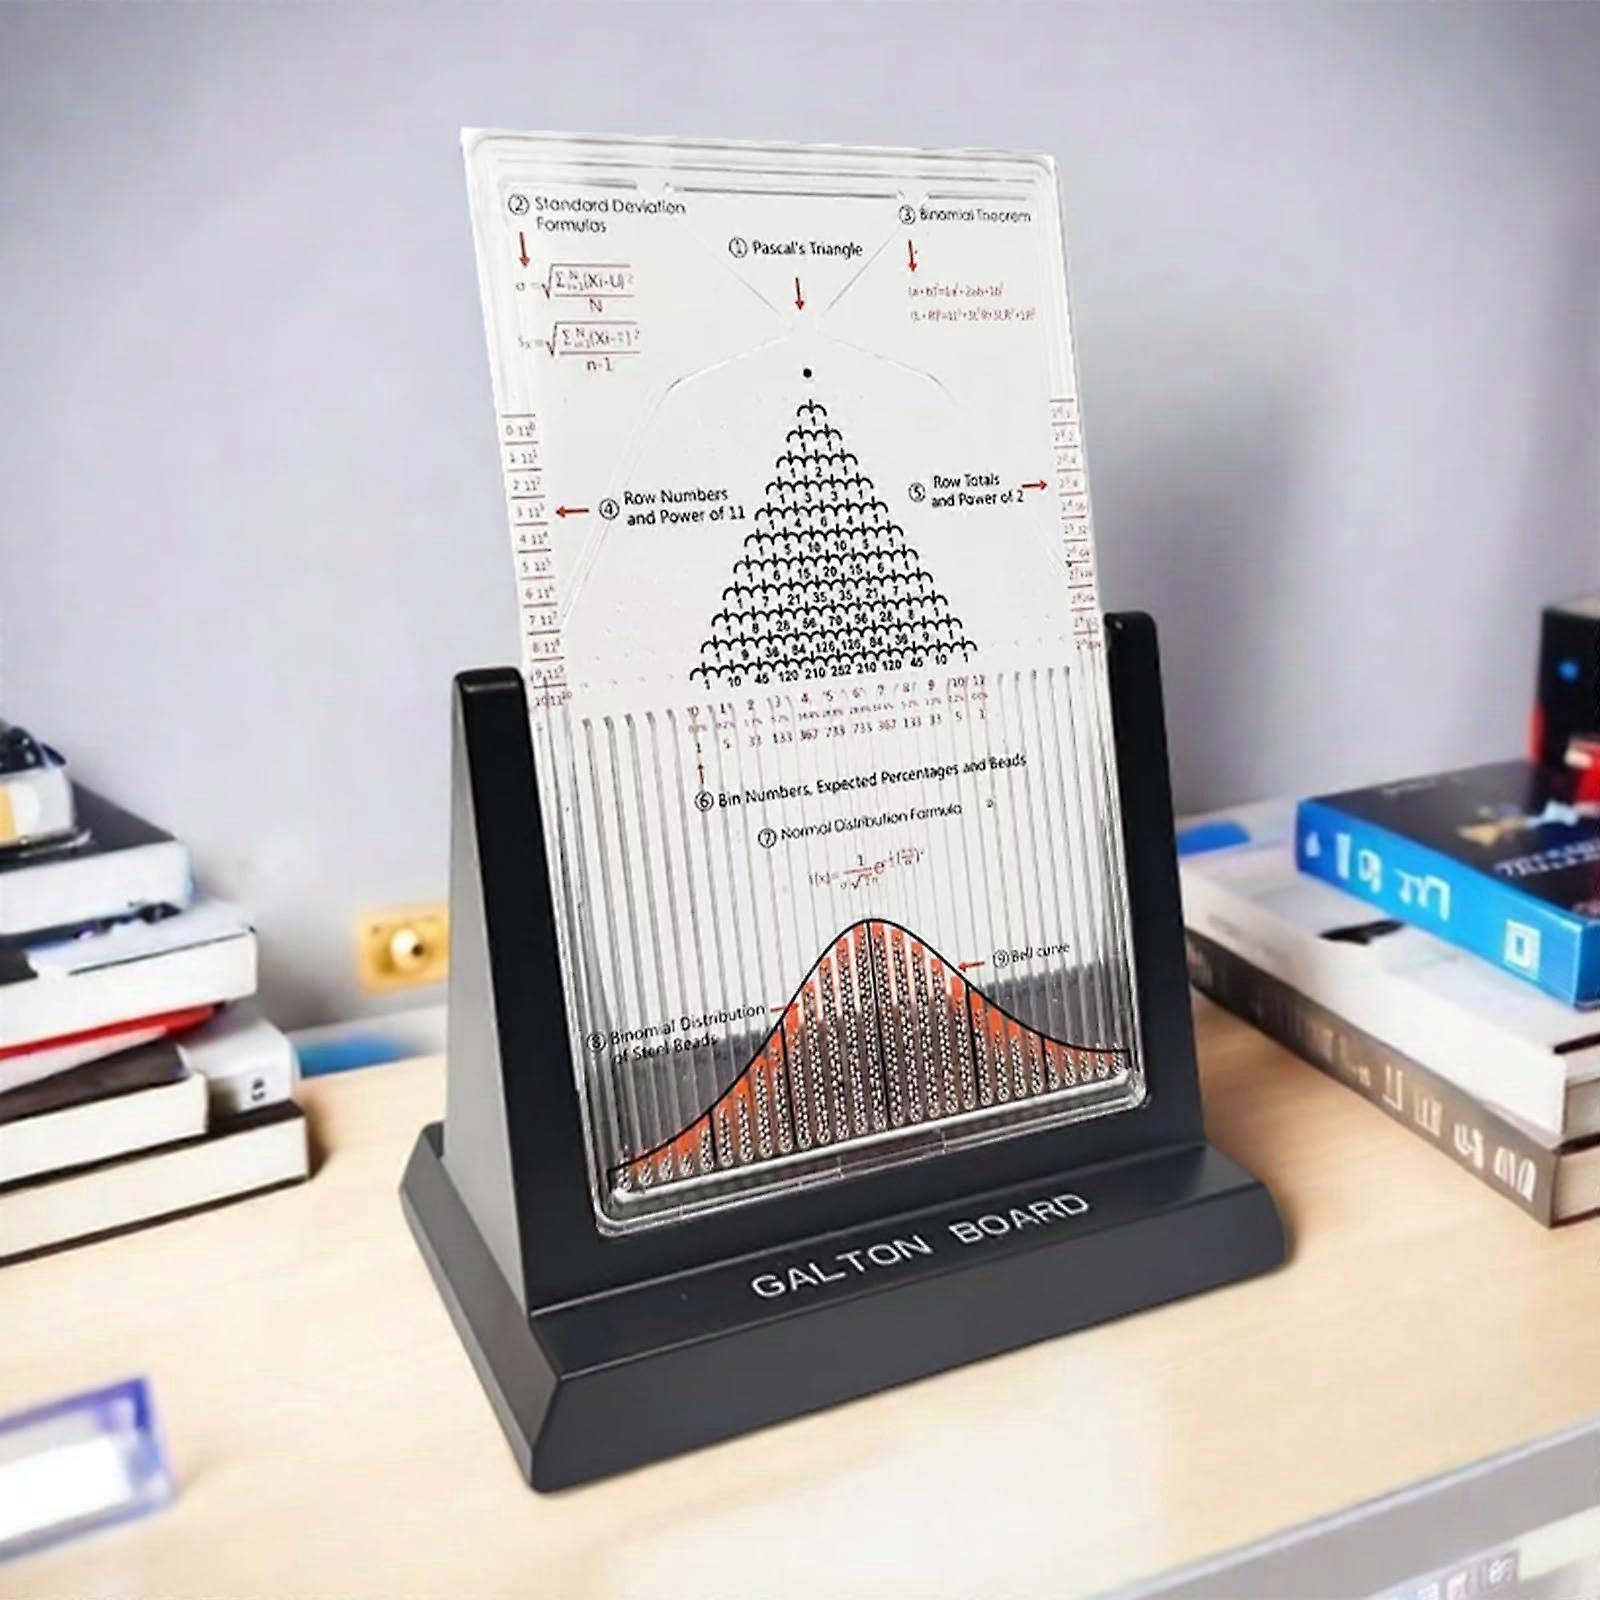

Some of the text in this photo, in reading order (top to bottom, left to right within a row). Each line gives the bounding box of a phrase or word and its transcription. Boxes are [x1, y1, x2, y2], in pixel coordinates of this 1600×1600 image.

[535, 197, 609, 213] Standard
[612, 200, 686, 215] Deviation
[537, 217, 607, 233] Formulas
[752, 240, 806, 255] Pascal's
[809, 242, 862, 260] Triangle
[812, 416, 816, 426] 1
[802, 441, 831, 451] 1 1
[791, 466, 847, 478] 1 2 1
[934, 476, 960, 488] Row
[964, 474, 1000, 486] Totals
[624, 491, 655, 504] Row
[661, 489, 728, 503] Numbers
[780, 490, 862, 503] 1 3 3 1
[932, 491, 1023, 508] and Power of 2
[628, 506, 745, 526] and Power of 11
[769, 514, 878, 529] 1 4 6 4 1
[759, 546, 763, 555] 1
[785, 544, 791, 554] 5
[808, 542, 821, 552] 10
[834, 541, 847, 551] 10
[889, 538, 893, 546] 1
[749, 561, 909, 582] 1 6 15 20 15 6 1
[738, 584, 923, 608] 1 7 21 35 35 21 7 1
[727, 626, 731, 635] 1
[753, 624, 759, 633] 8
[776, 621, 790, 632] 28
[803, 618, 816, 629] 56
[829, 615, 842, 626] 70
[855, 613, 868, 624] 56
[880, 611, 893, 622] 28
[935, 607, 938, 616] 1
[717, 652, 720, 662] 1
[792, 645, 805, 655] 84
[817, 641, 834, 652] 126
[842, 640, 861, 650] 126
[870, 637, 882, 647] 84
[923, 632, 929, 642] 9
[950, 630, 953, 639] 1
[705, 652, 968, 689] 1 10 45 120 210 252 210 120 45 10 1
[719, 793, 741, 808] Bin
[817, 776, 877, 795] Expected
[881, 762, 959, 785] Percentages
[963, 759, 987, 774] and
[990, 754, 1026, 769] Beads
[781, 819, 832, 841] Normal
[835, 812, 908, 832] Distribution
[910, 804, 962, 821] Formula
[1012, 947, 1032, 962] Bell
[1036, 943, 1070, 957] curve
[681, 1005, 765, 1031] Distribution
[633, 1042, 669, 1060] Steel
[674, 1033, 717, 1052] Beads
[752, 1194, 1089, 1298] GALTON BOARD
